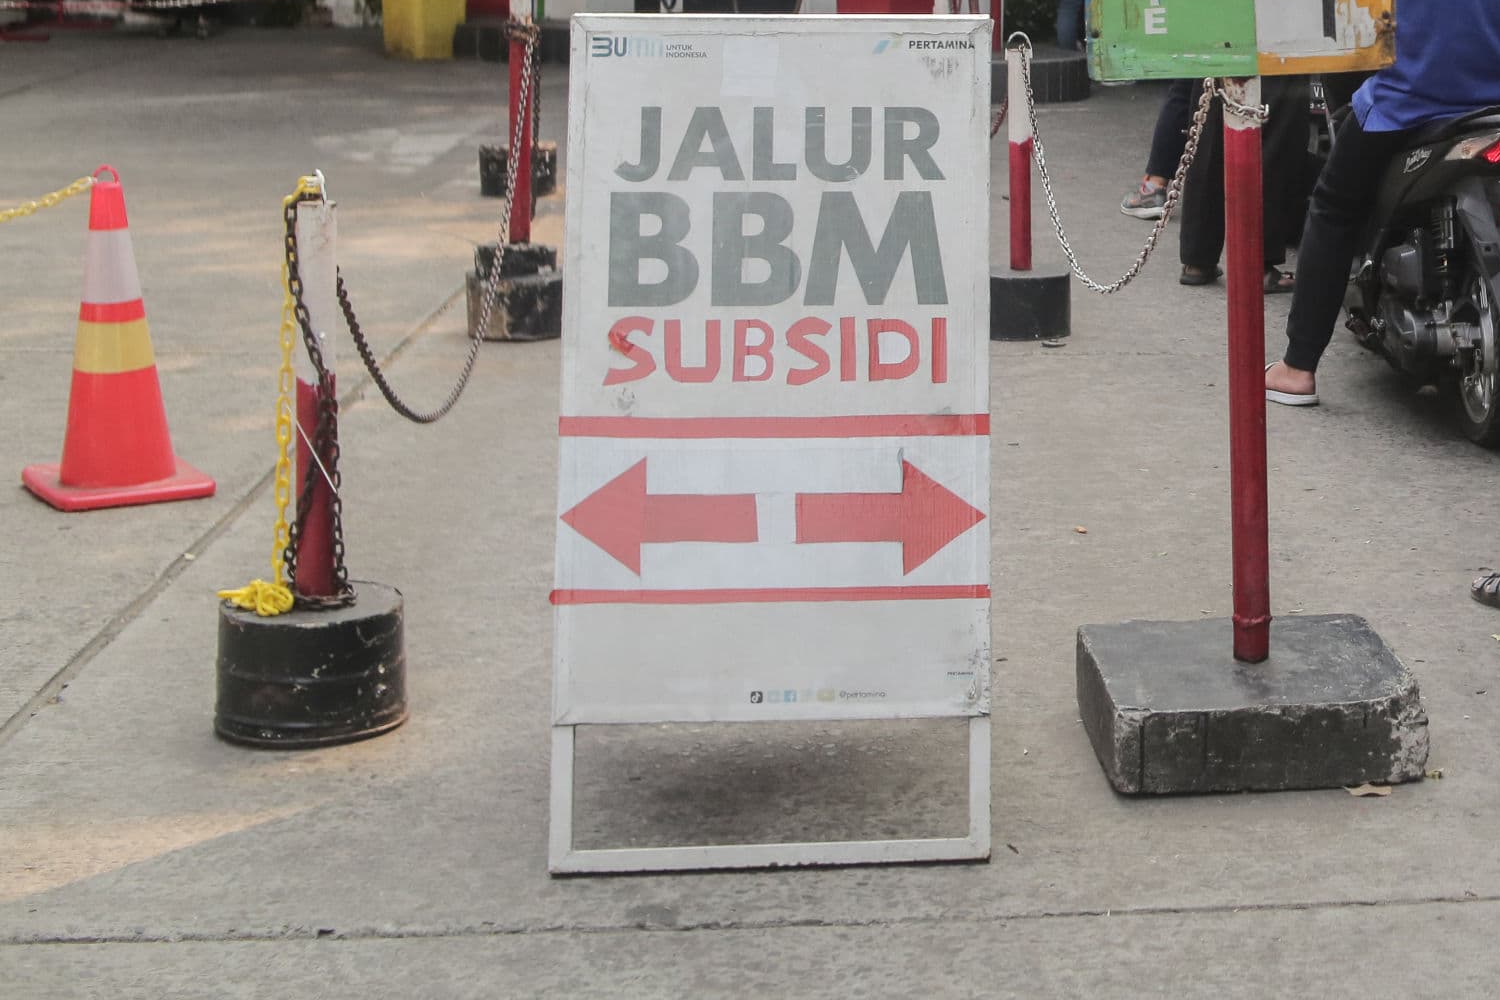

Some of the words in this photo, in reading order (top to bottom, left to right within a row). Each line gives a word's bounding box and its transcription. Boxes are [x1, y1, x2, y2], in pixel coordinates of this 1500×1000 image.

[665, 51, 708, 59] INDONESIA
[908, 40, 976, 50] PERTAMINA
[614, 106, 946, 183] JALUR
[608, 190, 949, 307] BBM
[602, 315, 948, 386] SUBSIDI
